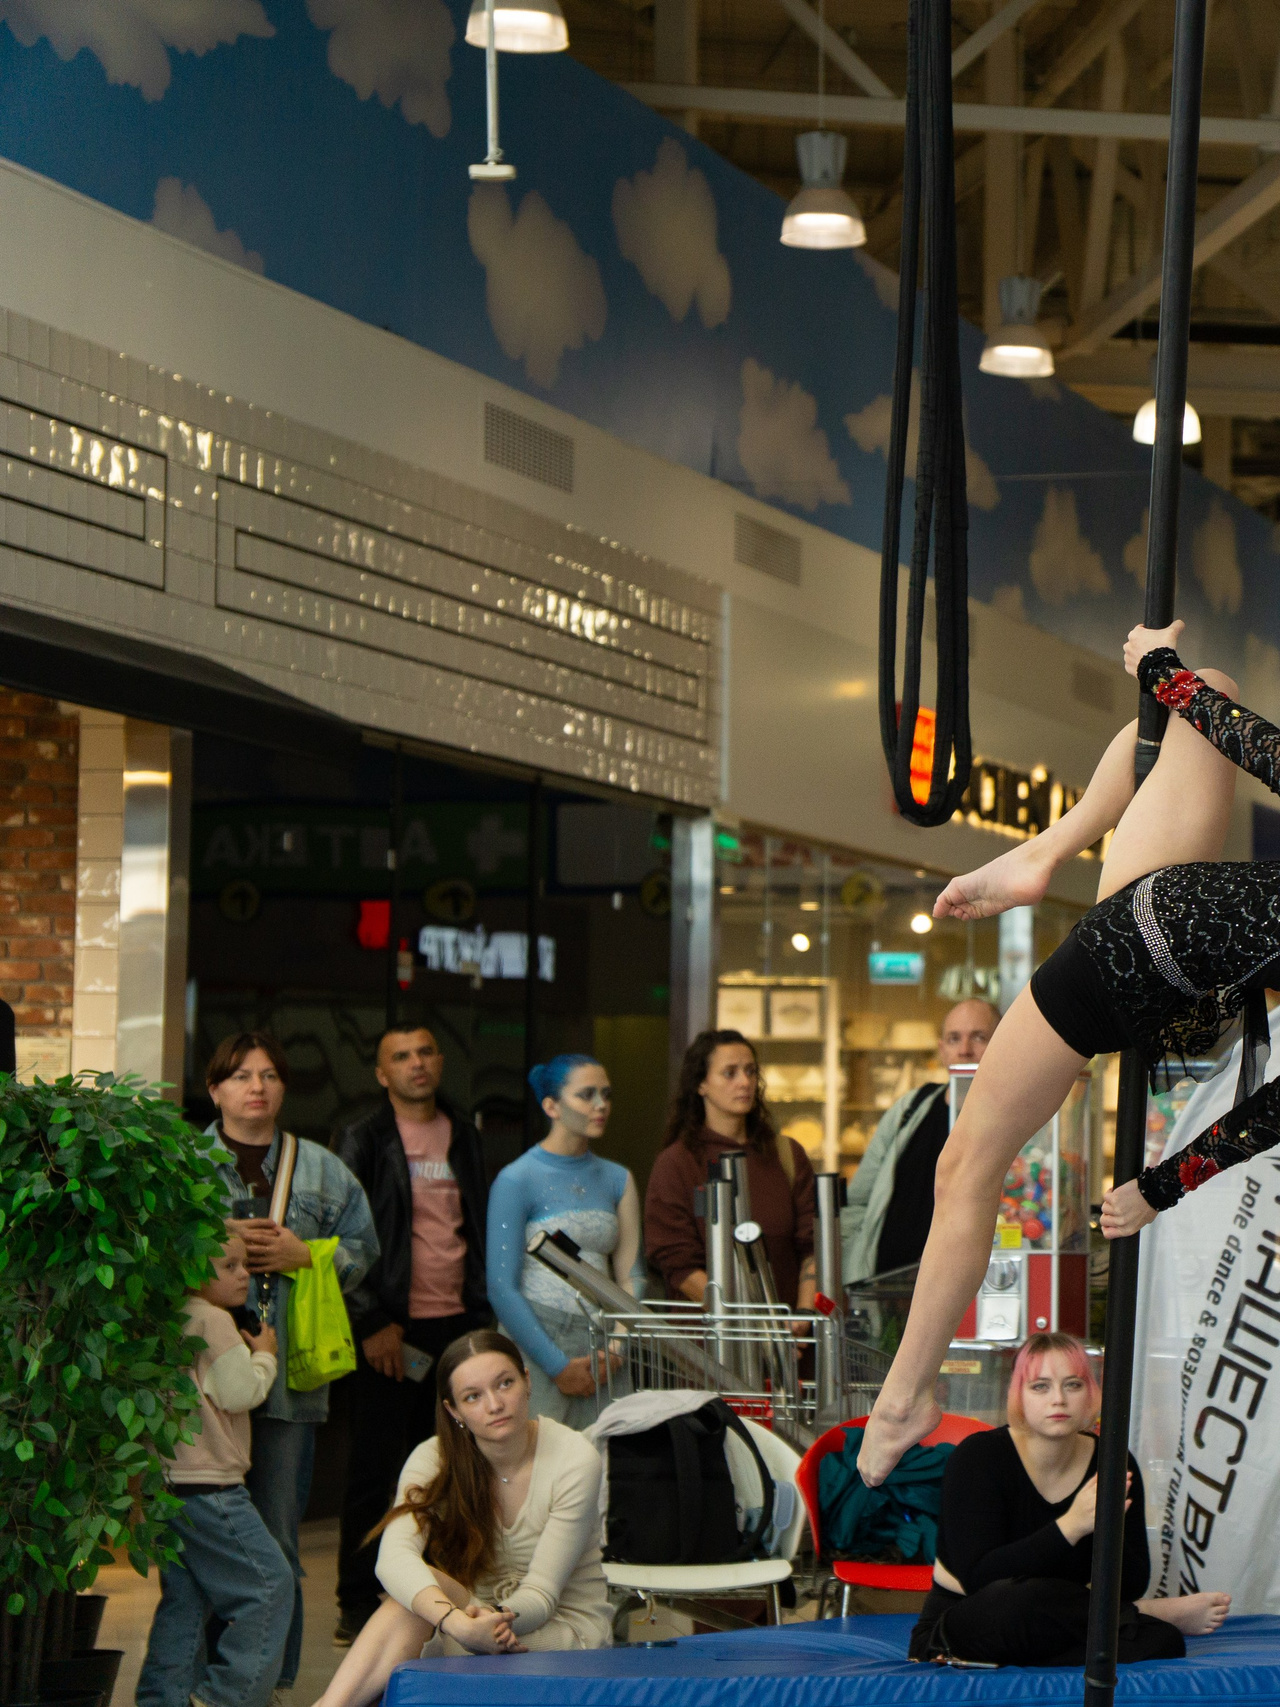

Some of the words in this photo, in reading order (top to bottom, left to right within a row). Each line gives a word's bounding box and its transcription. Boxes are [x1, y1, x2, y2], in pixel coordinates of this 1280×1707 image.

[1233, 1175, 1262, 1230] pole
[1206, 1234, 1243, 1306] dance
[1198, 1309, 1219, 1329] &
